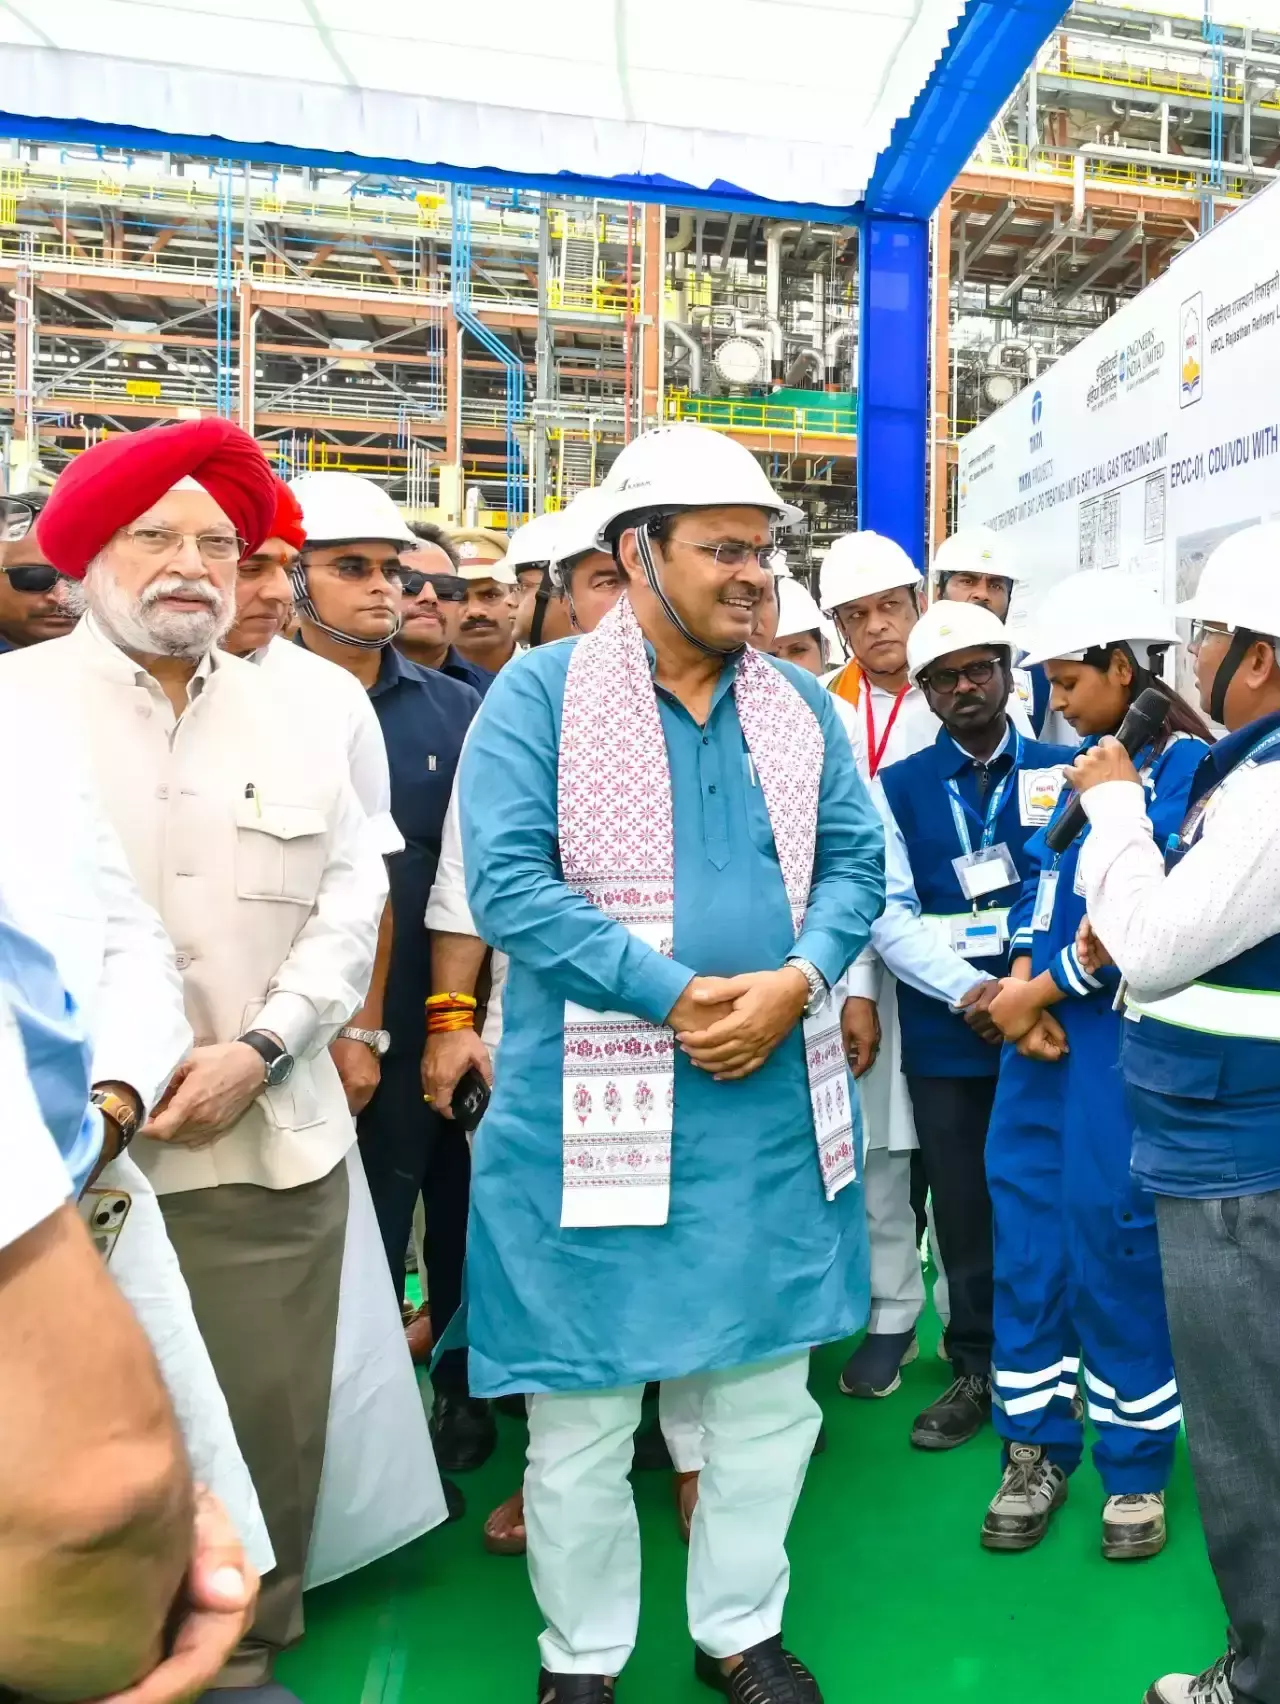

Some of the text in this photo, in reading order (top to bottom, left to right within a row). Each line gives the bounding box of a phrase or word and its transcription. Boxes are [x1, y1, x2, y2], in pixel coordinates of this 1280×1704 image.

[1225, 323, 1251, 348] Rajasthan
[1252, 310, 1275, 333] Refinery
[1120, 440, 1151, 475] TREATING
[1151, 432, 1168, 462] UNIT
[1170, 452, 1206, 489] EPCC-01,
[1208, 436, 1250, 475] CDU/VDU
[1252, 423, 1278, 460] WITH
